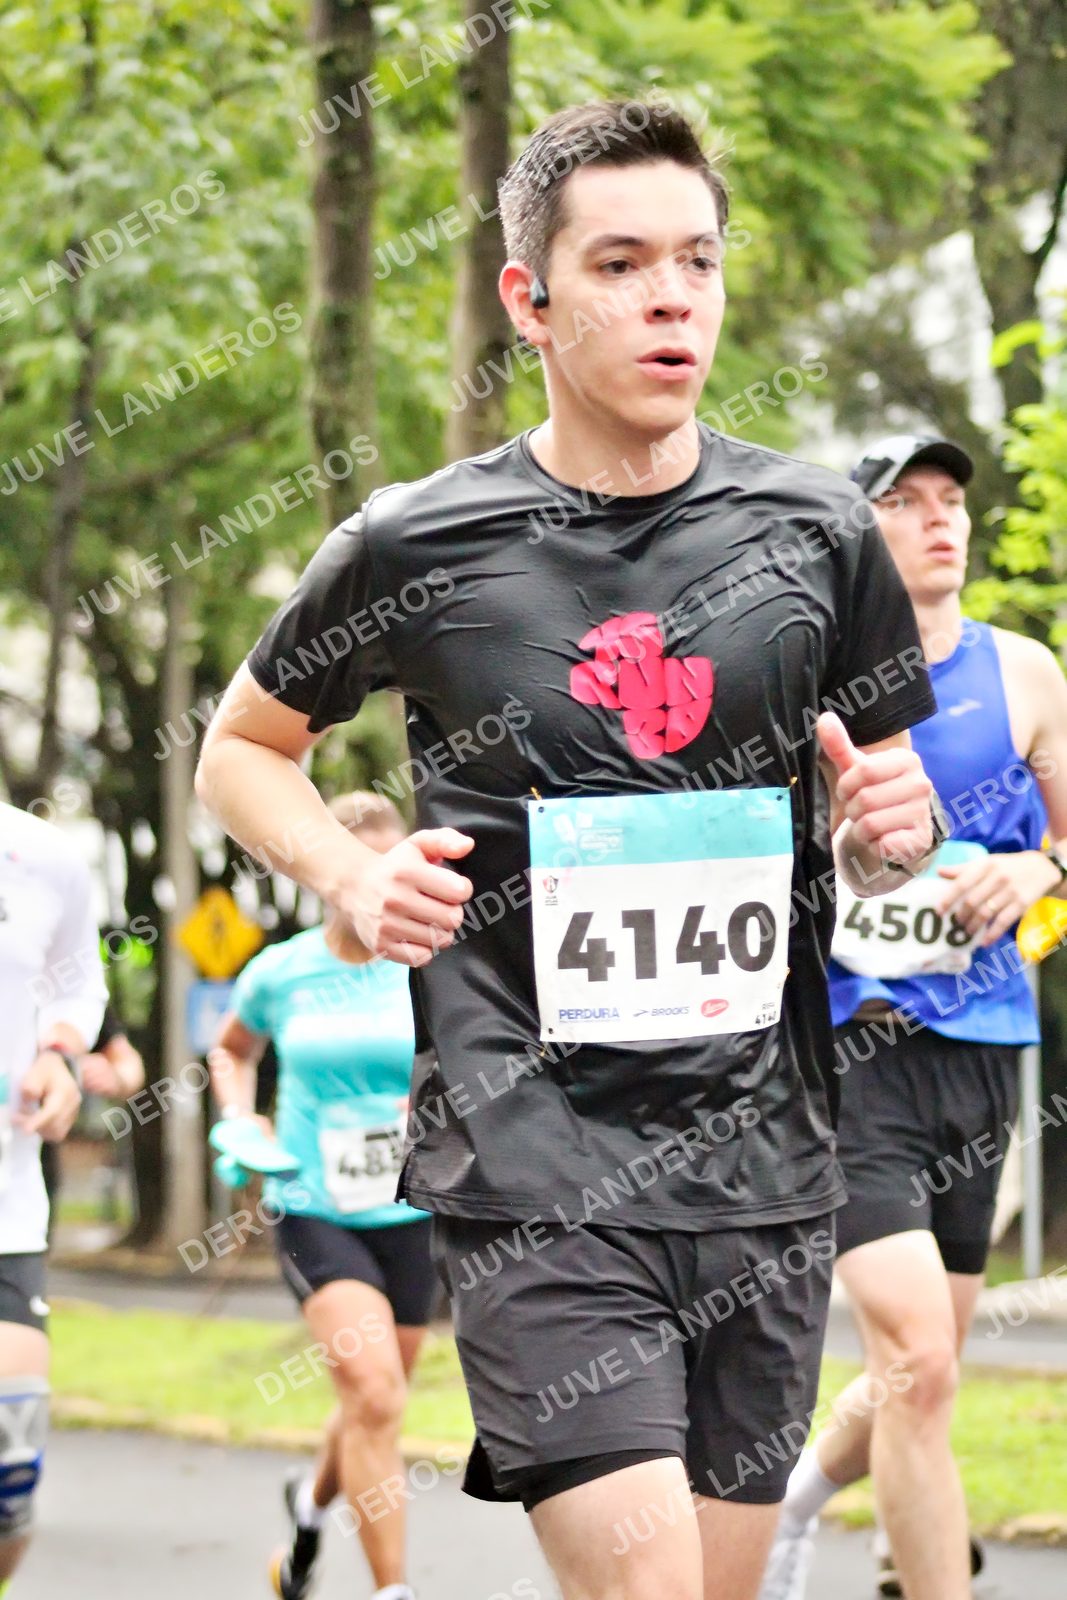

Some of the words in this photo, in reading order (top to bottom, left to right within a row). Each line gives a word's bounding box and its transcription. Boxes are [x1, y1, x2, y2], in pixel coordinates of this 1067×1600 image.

[843, 900, 972, 946] 4508
[558, 901, 776, 982] 4140
[559, 1008, 619, 1019] PERDURA
[651, 1006, 690, 1017] BROOKS
